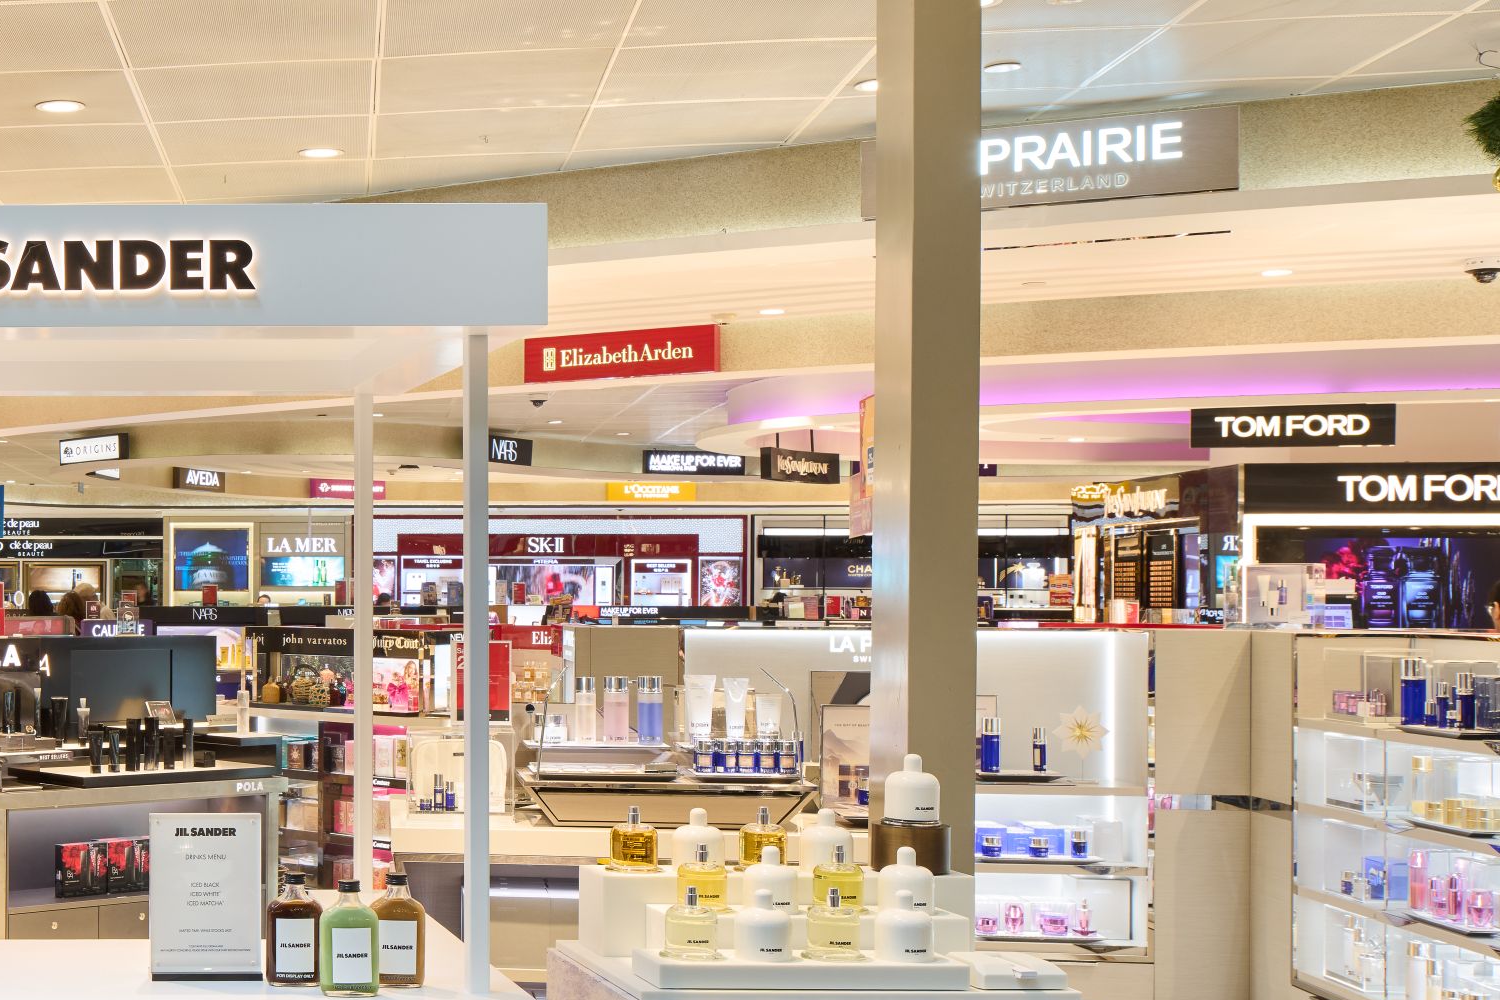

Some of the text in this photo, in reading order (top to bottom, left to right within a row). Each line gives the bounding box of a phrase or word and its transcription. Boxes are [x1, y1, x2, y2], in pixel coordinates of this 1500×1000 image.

[980, 121, 1184, 177] PRAIRIE
[981, 171, 1131, 199] WITZERLAND
[560, 341, 694, 368] Elizabeth Arden
[1214, 413, 1370, 438] TOM FORD
[75, 442, 118, 456] ORIGINS
[491, 438, 518, 462] NARS
[696, 455, 716, 467] FOR
[716, 456, 742, 467] EVER
[185, 469, 220, 487] AVEDA
[1337, 474, 1500, 502] TOM FOR
[267, 537, 338, 553] LA MER
[527, 536, 565, 554] SK-II
[847, 564, 872, 574] CHA
[192, 608, 218, 620] NARS
[92, 624, 145, 637] CAUE
[282, 633, 348, 647] john varvatos
[829, 635, 856, 653] LA
[236, 782, 264, 792] POLA
[174, 827, 237, 837] JIL SANDER
